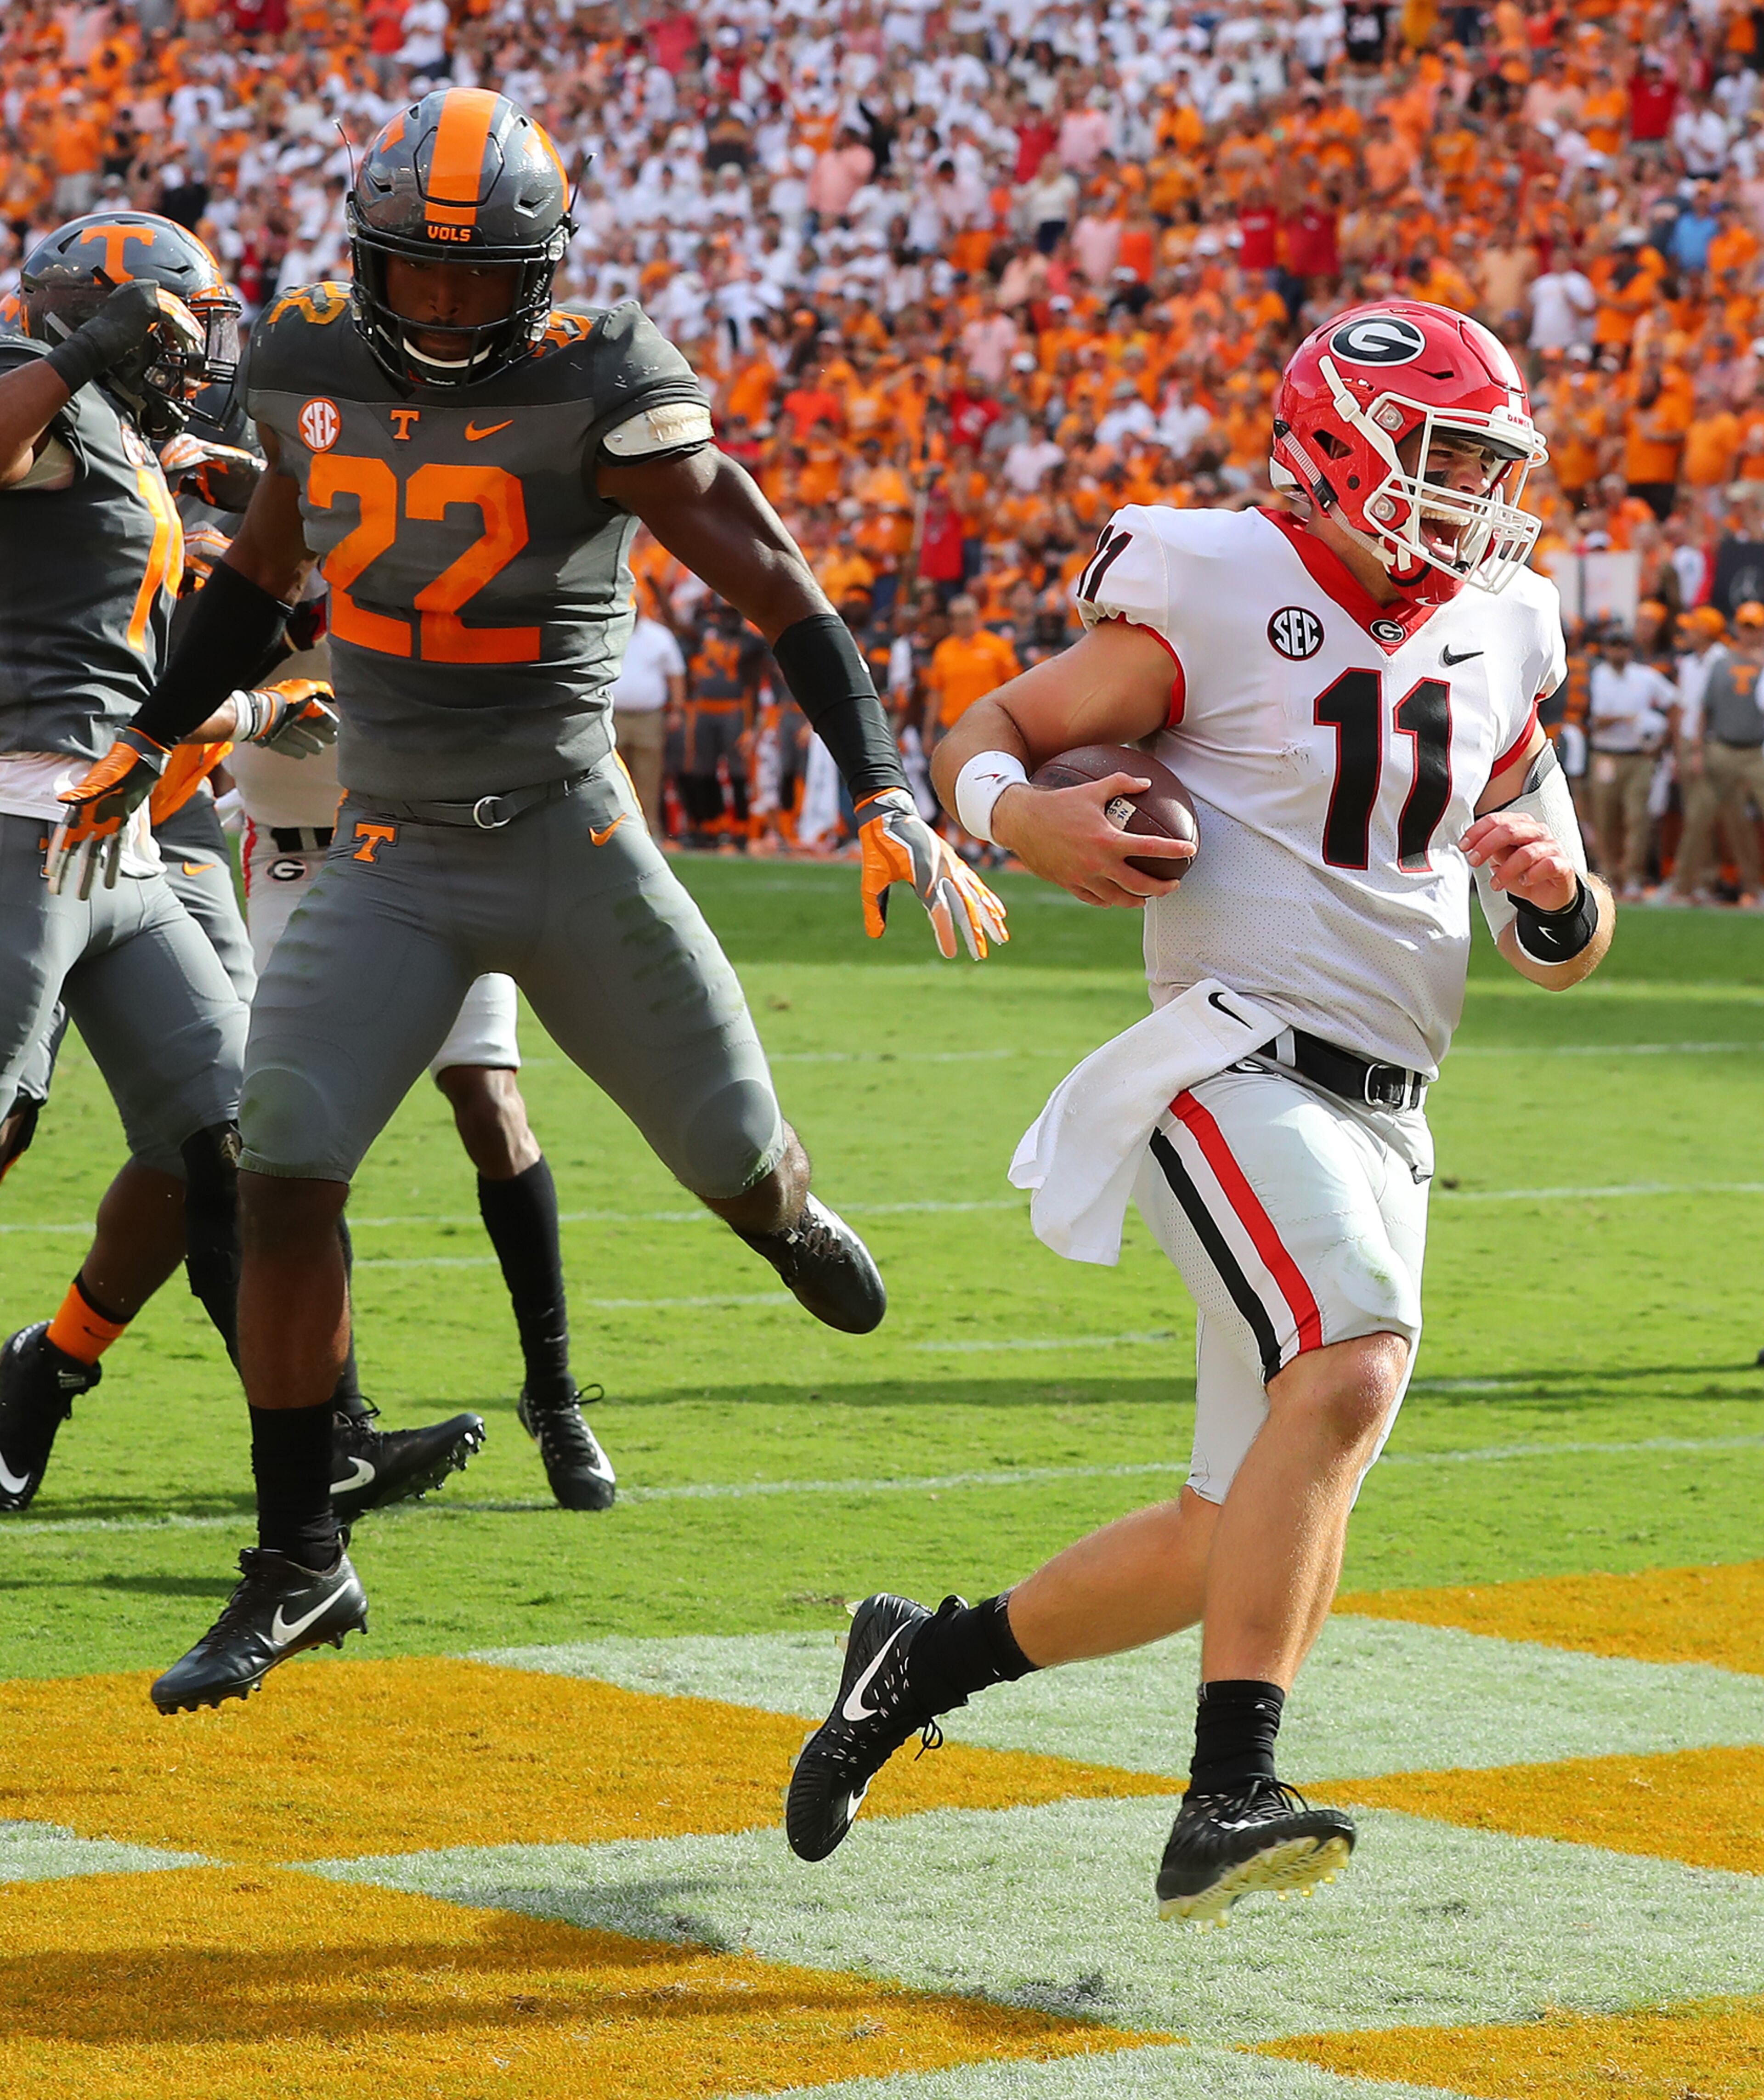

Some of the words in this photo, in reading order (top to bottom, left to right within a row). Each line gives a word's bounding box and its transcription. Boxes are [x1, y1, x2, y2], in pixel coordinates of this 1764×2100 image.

[79, 225, 155, 285] T
[427, 225, 471, 242] VOLS
[1339, 318, 1425, 360] G
[301, 401, 338, 449] SEC
[390, 409, 420, 440] T
[307, 453, 542, 664] 22
[1076, 523, 1134, 604] 11
[1272, 609, 1321, 657] SEC
[1374, 622, 1402, 640] G
[1313, 667, 1453, 873] 11
[353, 822, 396, 863] T
[270, 859, 307, 880] G
